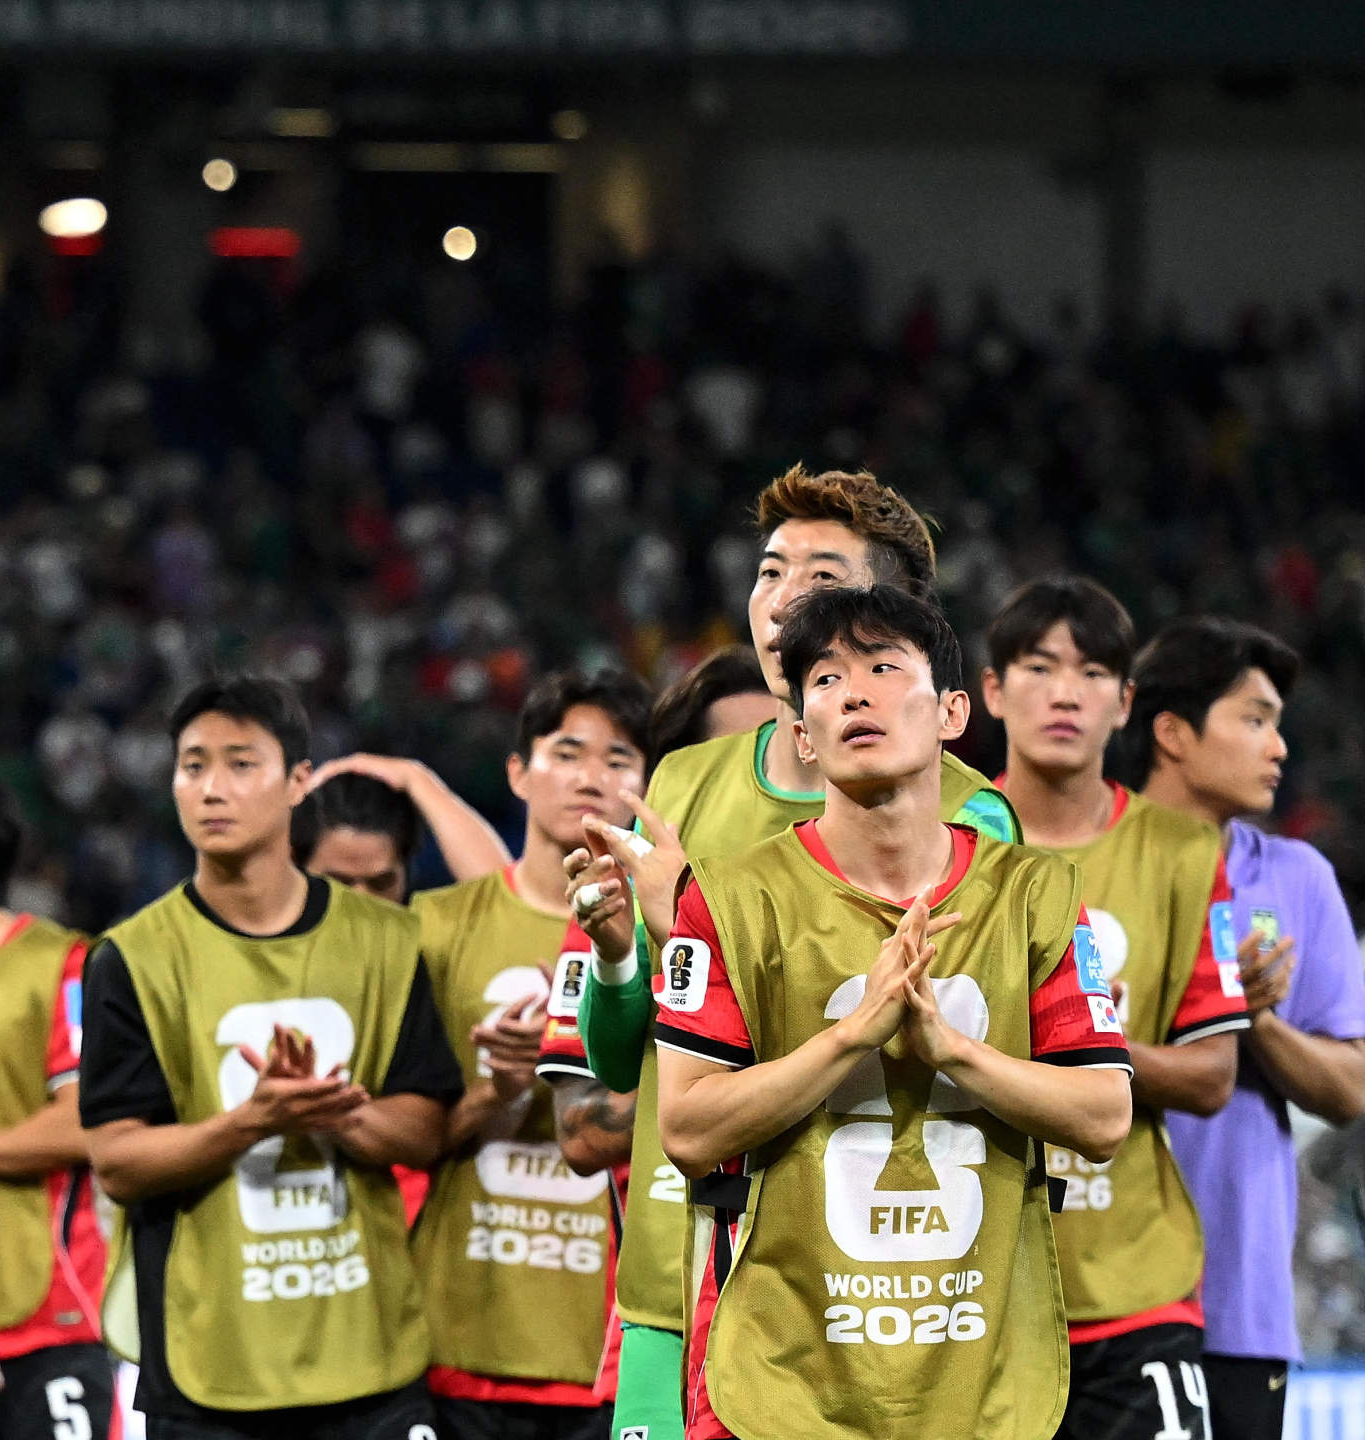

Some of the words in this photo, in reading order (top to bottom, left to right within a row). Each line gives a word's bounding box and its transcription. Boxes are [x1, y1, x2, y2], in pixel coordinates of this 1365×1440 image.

[273, 1183, 332, 1209] FIFA
[1061, 1174, 1113, 1212] 26
[471, 1200, 551, 1231] WORLD
[554, 1211, 606, 1238] CUP
[869, 1205, 950, 1235] FIFA
[241, 1236, 325, 1265] WORLD
[465, 1226, 602, 1274] 2026
[241, 1253, 370, 1302] 2026
[823, 1273, 929, 1300] WORLD
[939, 1269, 984, 1298] CUP
[824, 1302, 987, 1346] 2026
